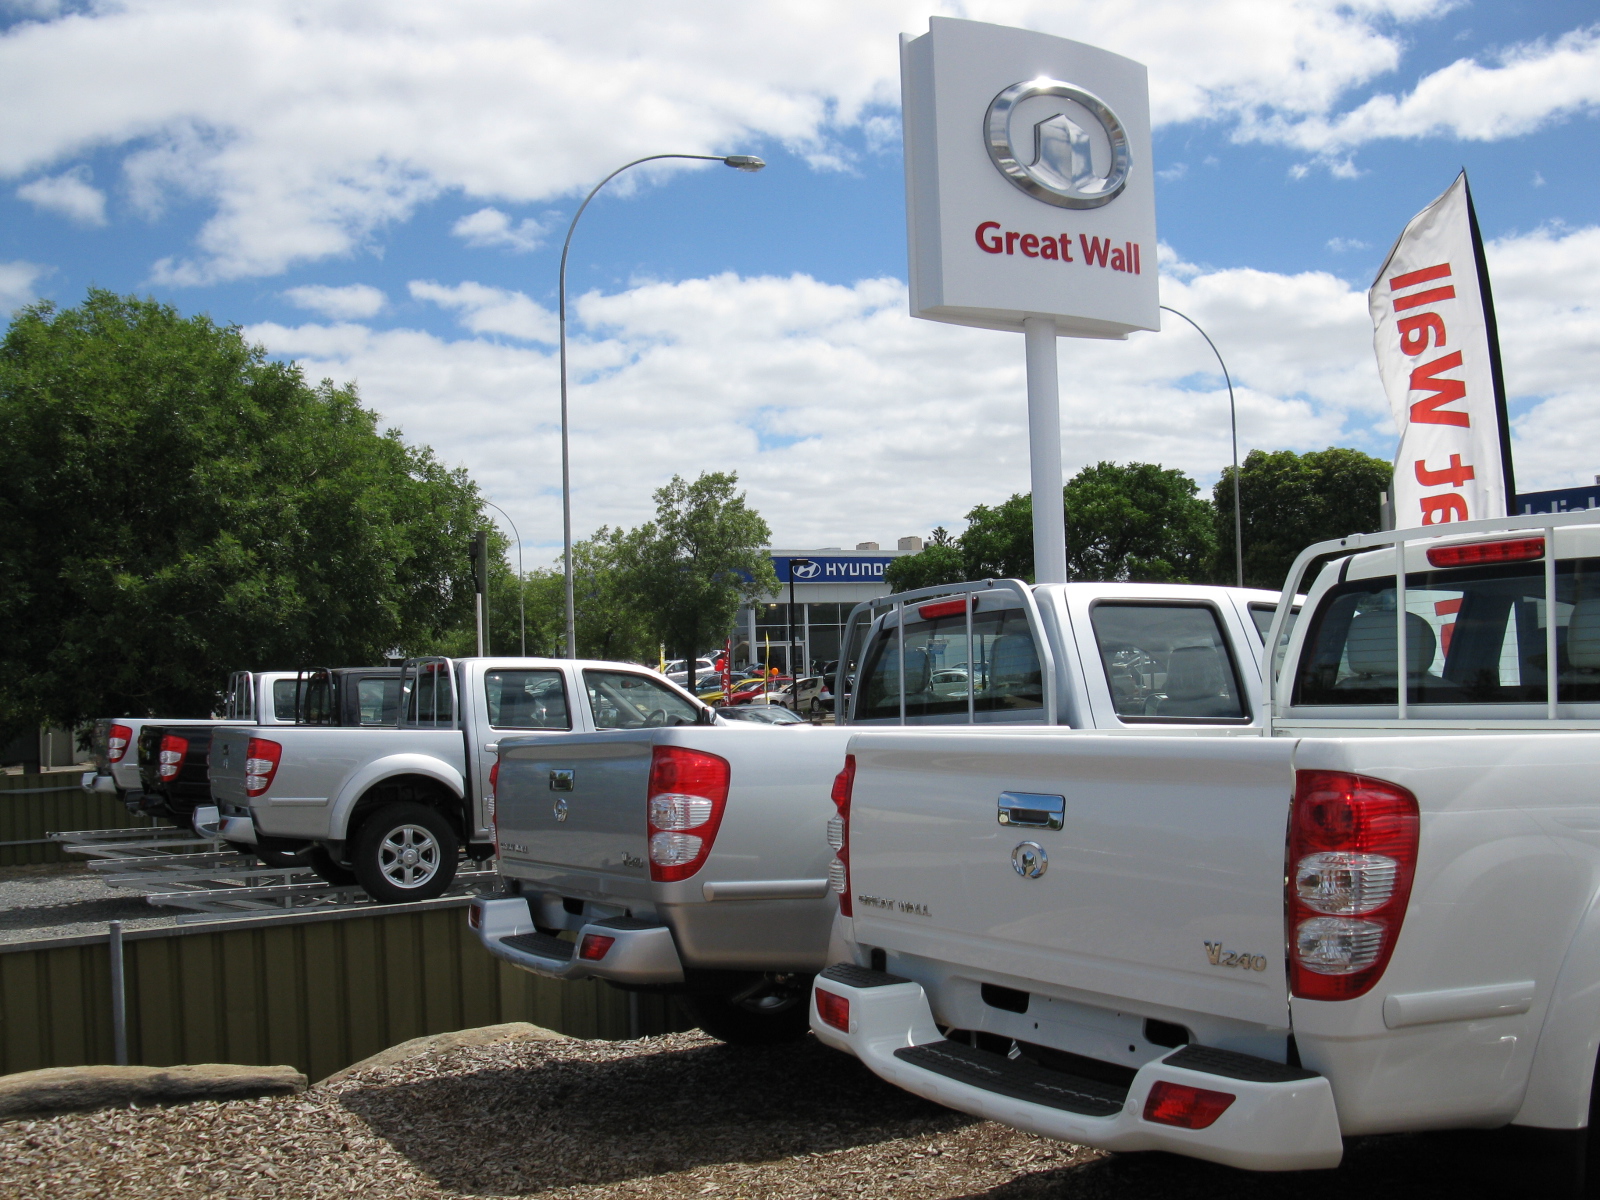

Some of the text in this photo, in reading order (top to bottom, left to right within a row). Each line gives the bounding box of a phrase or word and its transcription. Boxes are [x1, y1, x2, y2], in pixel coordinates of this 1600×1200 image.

[975, 220, 1140, 275] Great Wall
[826, 562, 889, 576] HYUND
[1203, 940, 1267, 972] V240
